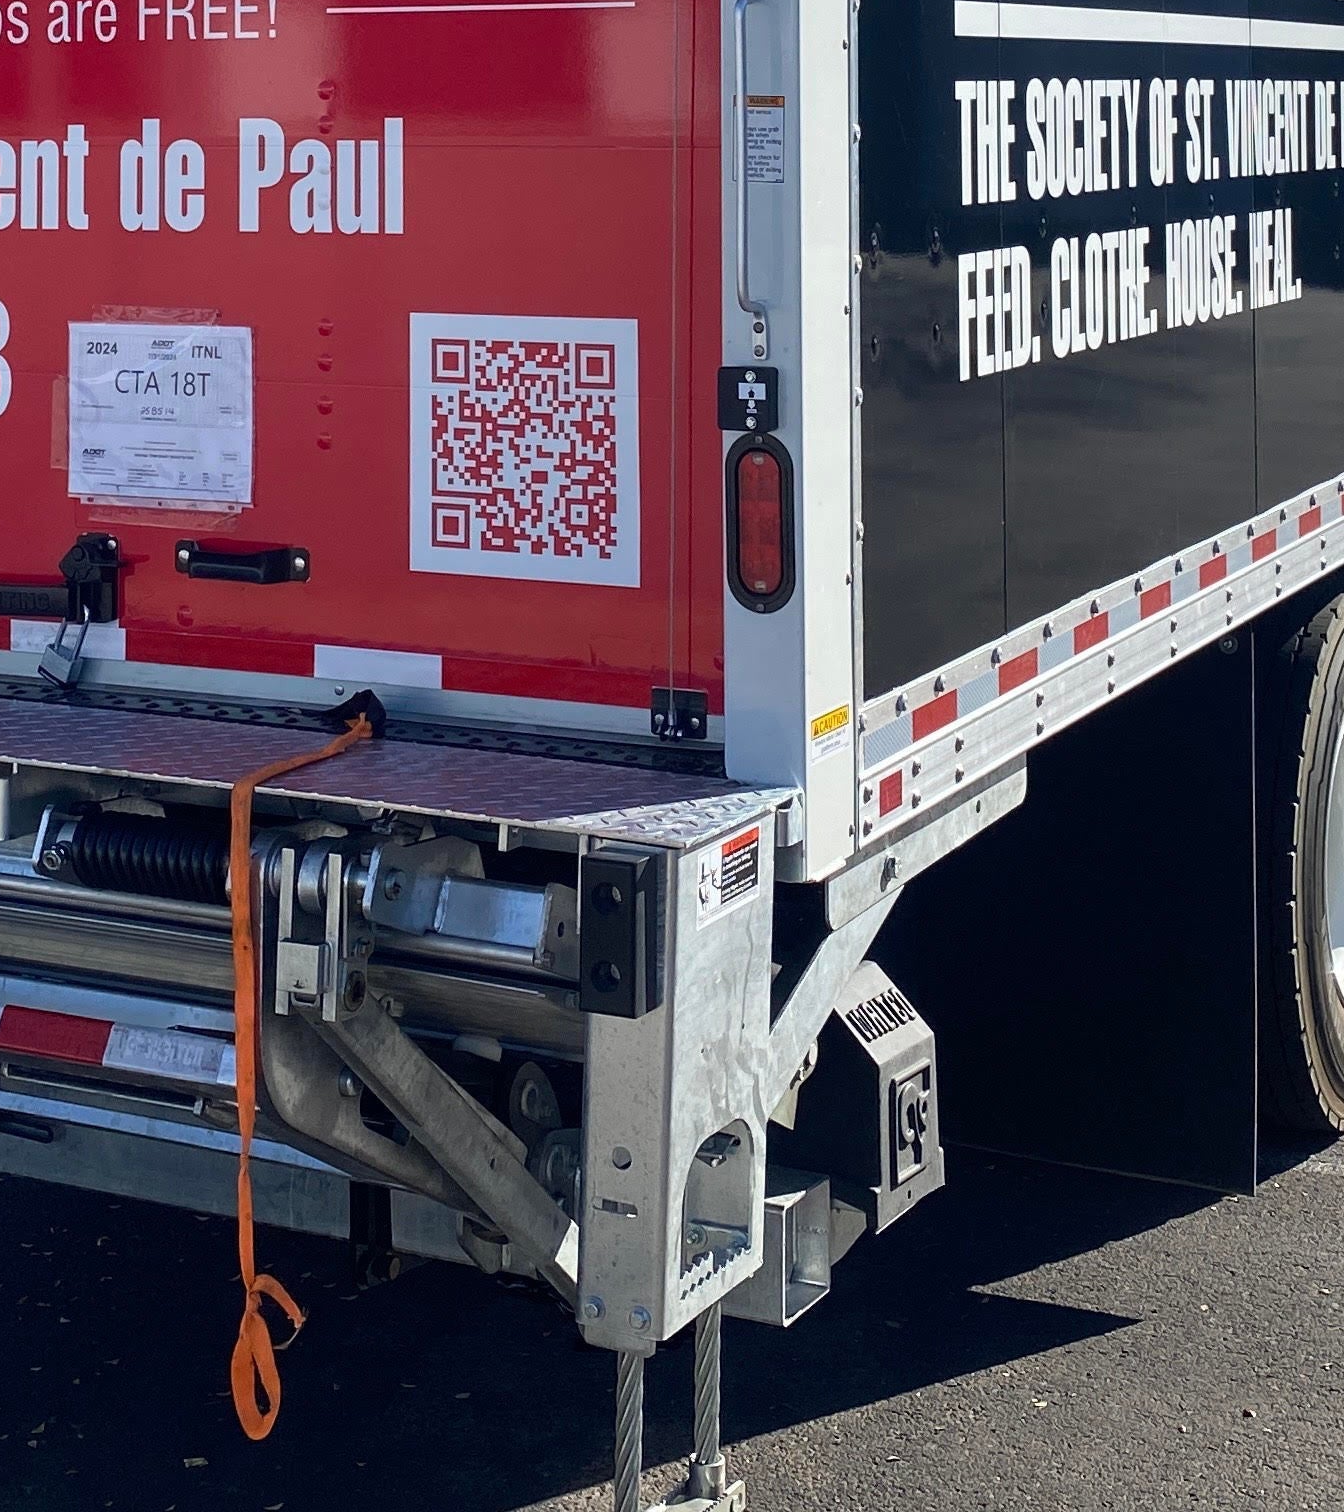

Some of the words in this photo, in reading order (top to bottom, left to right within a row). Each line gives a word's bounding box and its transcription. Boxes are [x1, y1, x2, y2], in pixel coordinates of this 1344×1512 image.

[48, 0, 116, 43] are
[955, 81, 1016, 205] THE
[1026, 78, 1140, 199] SOCIETY
[1149, 78, 1177, 186] OF
[1186, 78, 1219, 183] ST.
[1226, 79, 1309, 177] VINCENT
[1315, 81, 1336, 170] DE
[120, 119, 204, 232] de
[239, 118, 403, 234] Paul
[958, 246, 1040, 381] FEED.
[1051, 227, 1157, 358] CLOTHE.
[1166, 215, 1243, 329] HOUSE.
[1249, 208, 1301, 309] HEAL.
[87, 342, 118, 355] 2024
[191, 345, 222, 359] ITNL
[115, 370, 160, 395] CTA
[171, 372, 211, 397] 18T
[820, 711, 847, 733] CAUTION
[845, 987, 917, 1044] WALTCO
